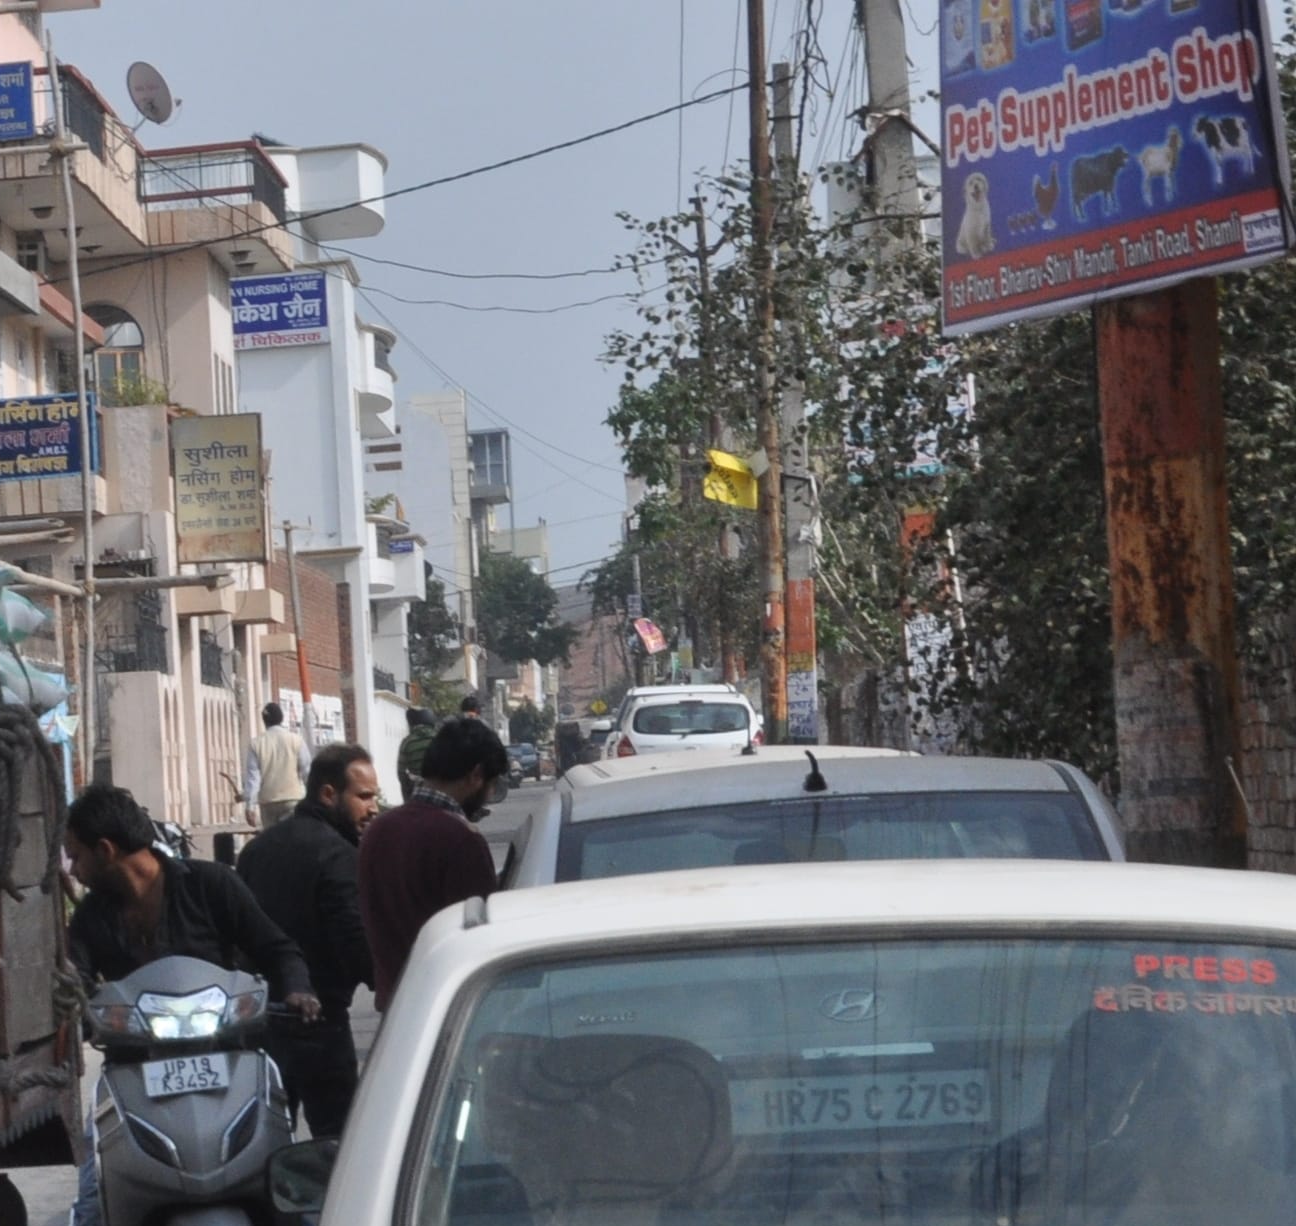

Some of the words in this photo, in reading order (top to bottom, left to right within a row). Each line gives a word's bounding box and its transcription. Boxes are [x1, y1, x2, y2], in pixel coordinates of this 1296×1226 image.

[948, 105, 995, 161] Pet
[999, 60, 1170, 149] Supplement
[1174, 30, 1257, 96] Shop
[1120, 232, 1154, 266] Tanki
[1195, 210, 1242, 251] Shamli
[244, 282, 288, 297] NURSING
[289, 280, 319, 292] HOME
[281, 292, 322, 319] जैन
[183, 440, 249, 467] सुशीला
[229, 466, 256, 485] होम
[1134, 954, 1277, 985] PRESS
[164, 1060, 186, 1076] UP
[191, 1057, 211, 1074] 19
[895, 1080, 984, 1121] 2769
